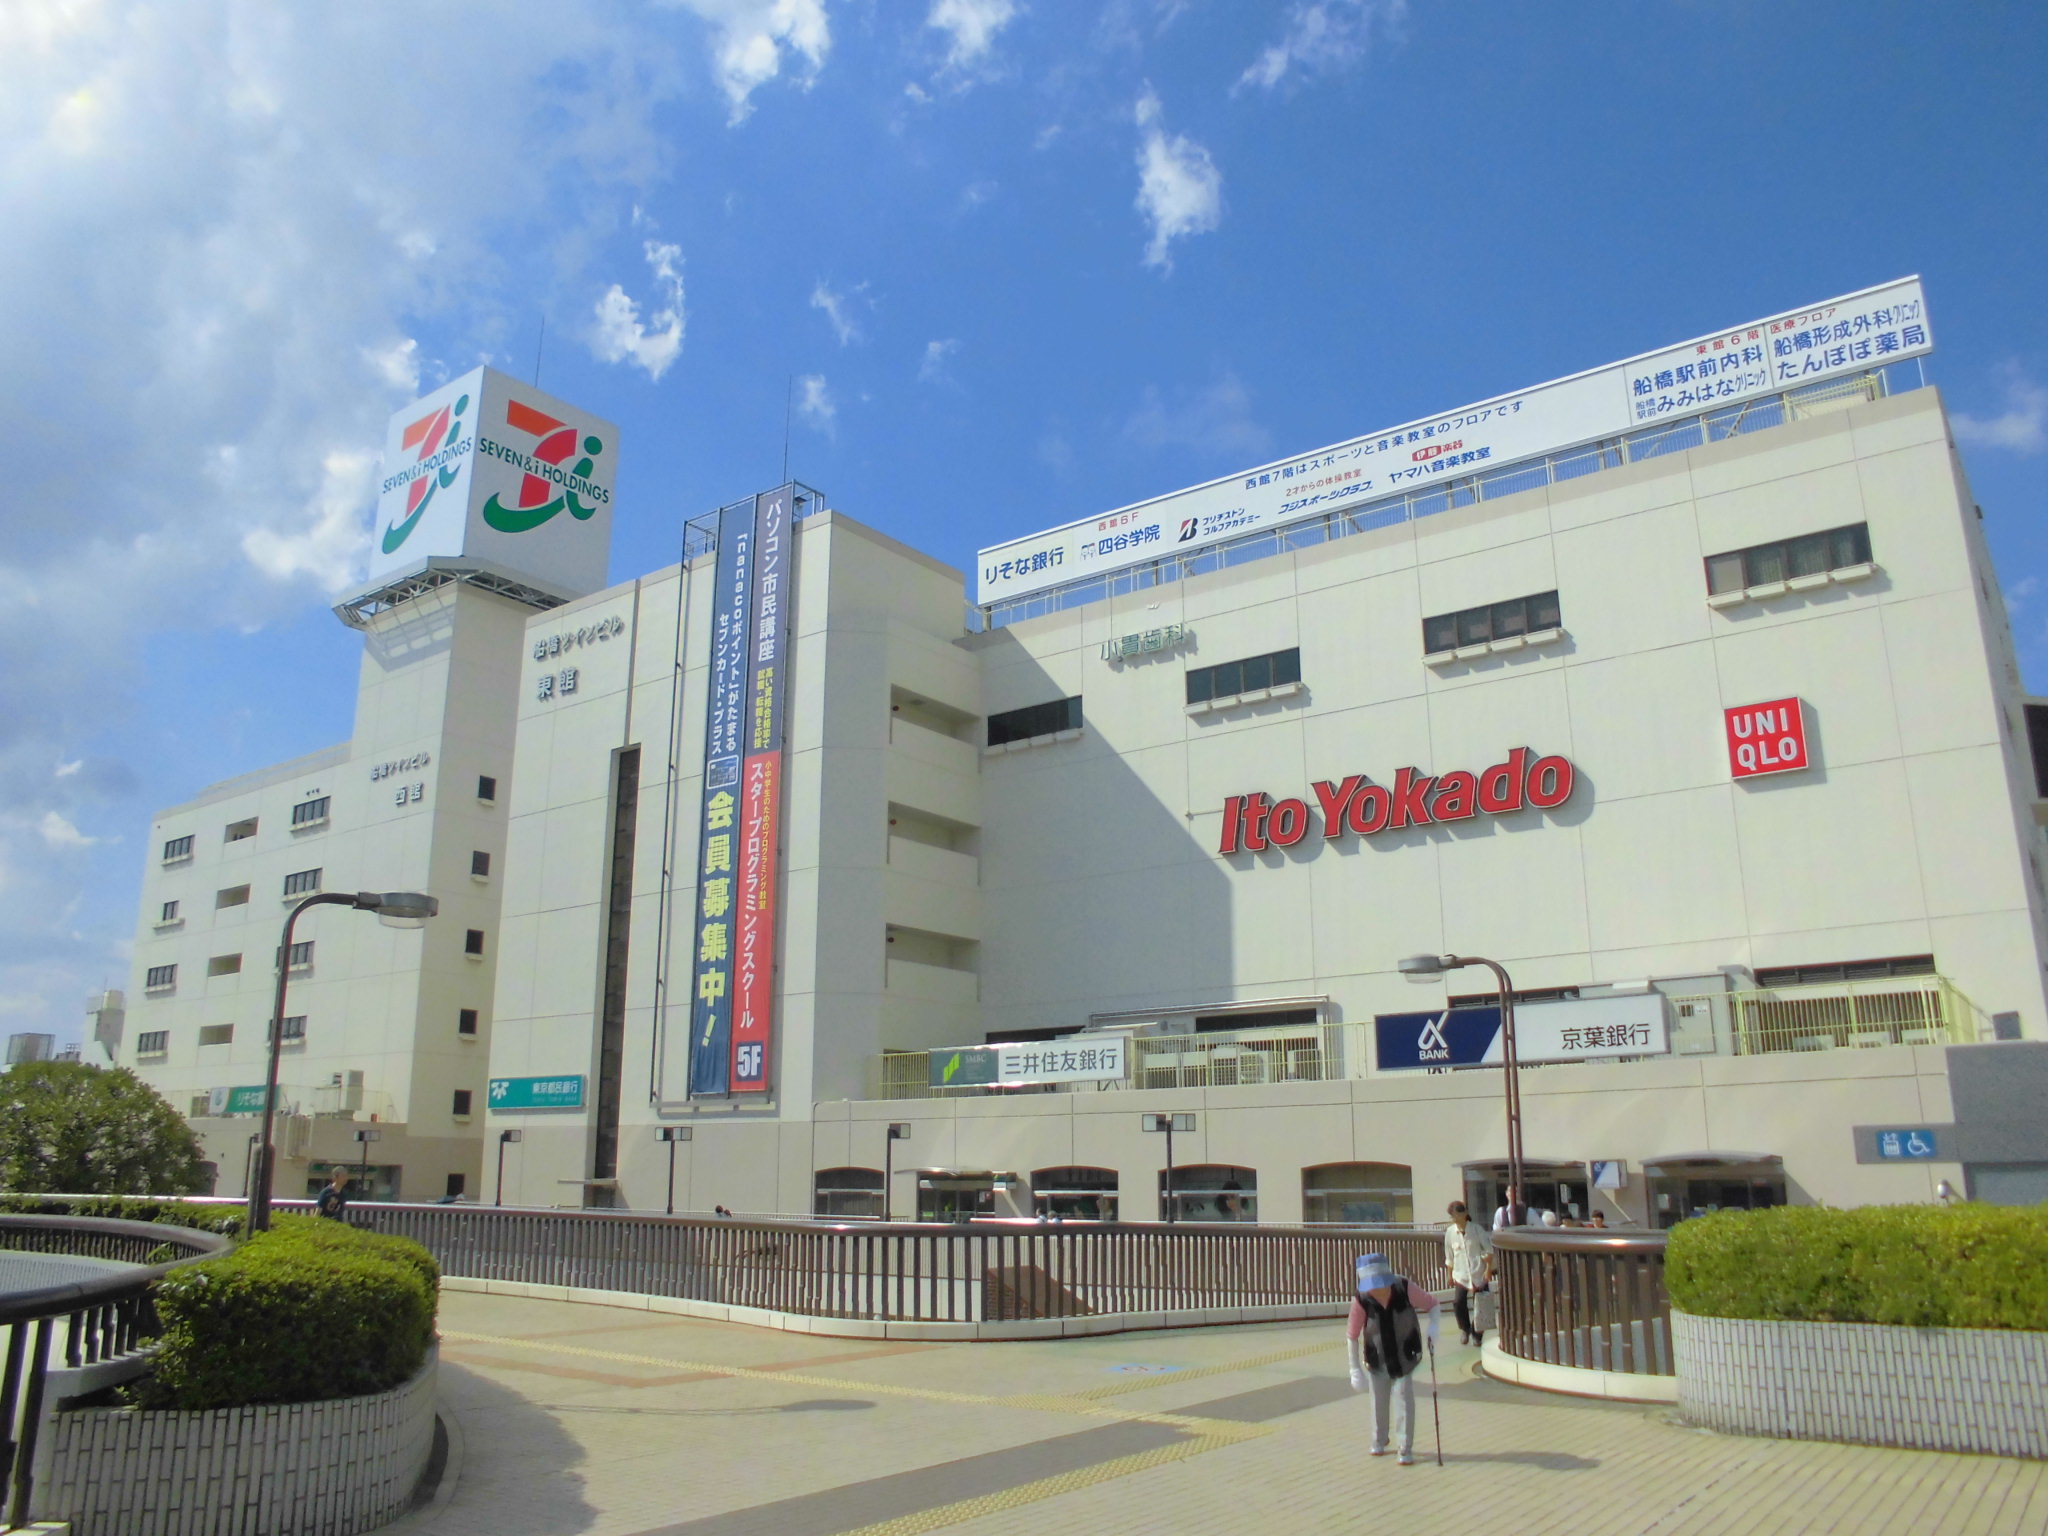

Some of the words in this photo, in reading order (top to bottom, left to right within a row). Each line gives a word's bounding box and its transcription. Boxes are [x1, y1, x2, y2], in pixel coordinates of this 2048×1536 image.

[1695, 330, 1760, 356] 東館6階
[1770, 307, 1836, 334] 医療フロア
[1773, 299, 1920, 358] 船橋形成外科クリニック
[1632, 345, 1763, 397] 船橋駅前内科
[1777, 324, 1926, 381] たんぽぽ薬局
[1657, 367, 1766, 412] みみはなクリニック
[382, 470, 412, 494] SEVEN
[423, 437, 472, 473] HOLDINGS
[479, 437, 523, 467] SEVEN
[524, 459, 534, 474] &
[542, 465, 609, 504] HOLDINGS
[1286, 468, 1362, 497] 2才からの体操教室
[1388, 446, 1491, 483] ヤマハ音楽教室
[1099, 524, 1160, 555] 四谷学院
[759, 498, 782, 662] パソコン市民講座
[985, 545, 1064, 585] りそな銀行
[538, 668, 578, 699] 東館
[712, 613, 729, 755] セブンカード・プラス
[1732, 706, 1790, 740] UNI
[1736, 736, 1799, 773] QLO
[1218, 792, 1310, 856] Ito
[1310, 746, 1574, 840] Yokado
[740, 762, 763, 1029] スタープログラミングスクール
[1419, 1049, 1449, 1060] BANK
[1560, 1023, 1651, 1050] 京葉銀行
[737, 1045, 762, 1077] 5F
[1005, 1048, 1118, 1075] 三井住友銀行
